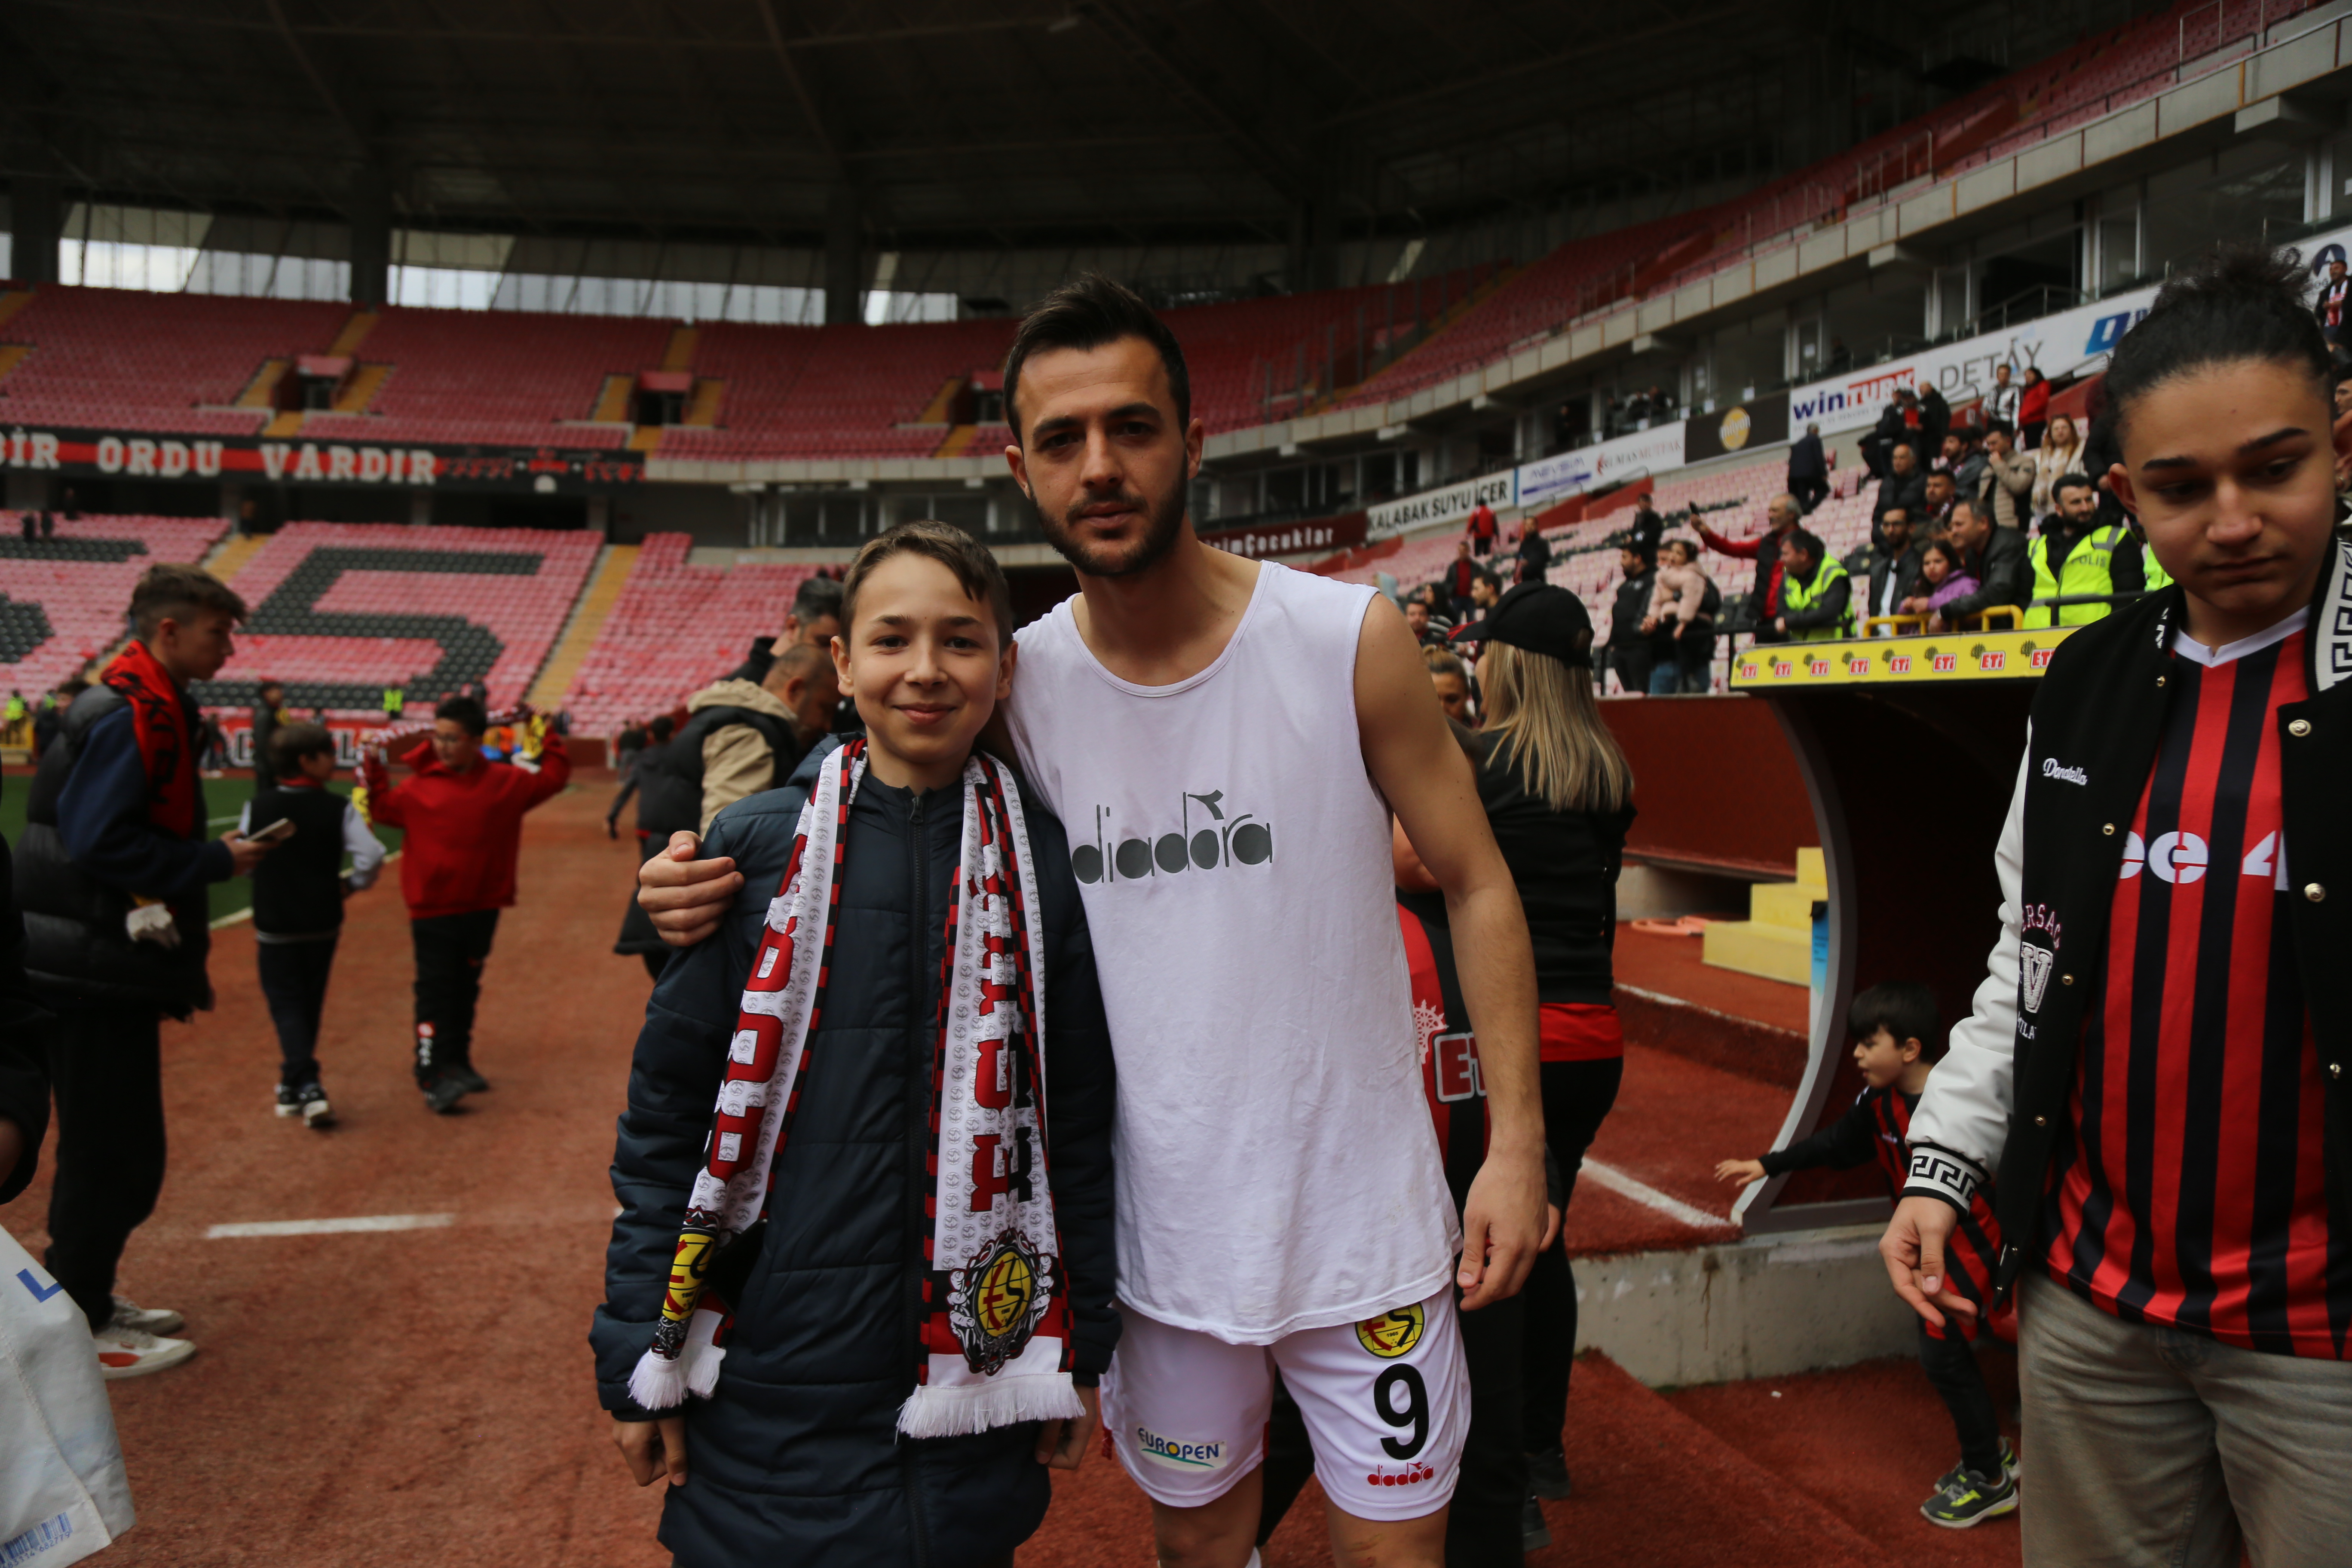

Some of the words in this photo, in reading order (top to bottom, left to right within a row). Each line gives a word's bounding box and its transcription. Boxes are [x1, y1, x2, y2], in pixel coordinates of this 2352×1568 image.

[0, 426, 59, 469] İR
[97, 436, 223, 477] ORDU
[260, 443, 435, 486] VARDIR
[2043, 758, 2088, 786] Donatella
[1072, 789, 1273, 884] diadora
[2021, 941, 2053, 1013] V
[1373, 1363, 1429, 1460] 9
[1138, 1427, 1219, 1460] EUROPEN
[1367, 1461, 1433, 1486] diadora
